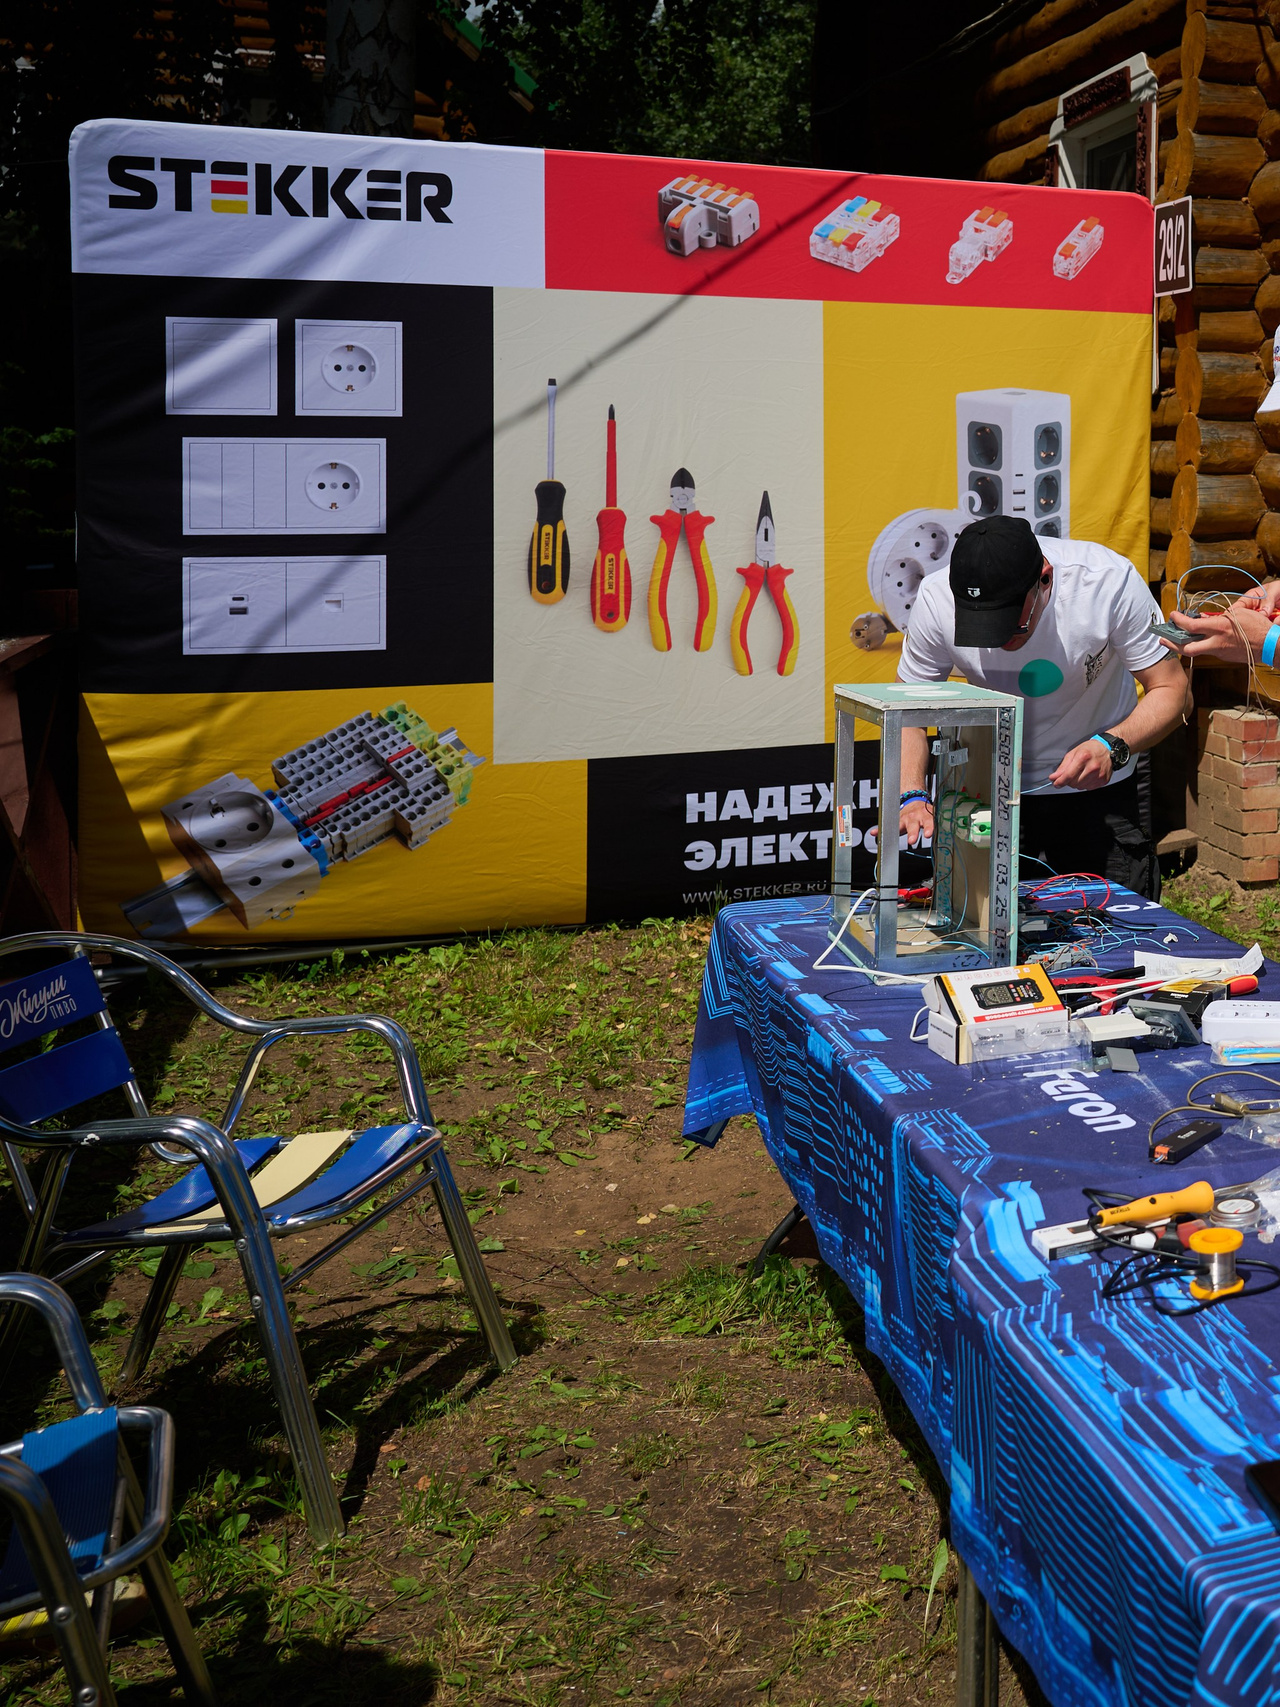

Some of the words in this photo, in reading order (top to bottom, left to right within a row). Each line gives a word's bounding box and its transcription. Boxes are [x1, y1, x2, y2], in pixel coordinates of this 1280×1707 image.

[107, 155, 454, 224] STEKKER
[1159, 214, 1185, 281] 29/2
[0, 975, 67, 1038] Жигули
[49, 998, 77, 1019] ПИВО
[1022, 1068, 1137, 1133] Feron
